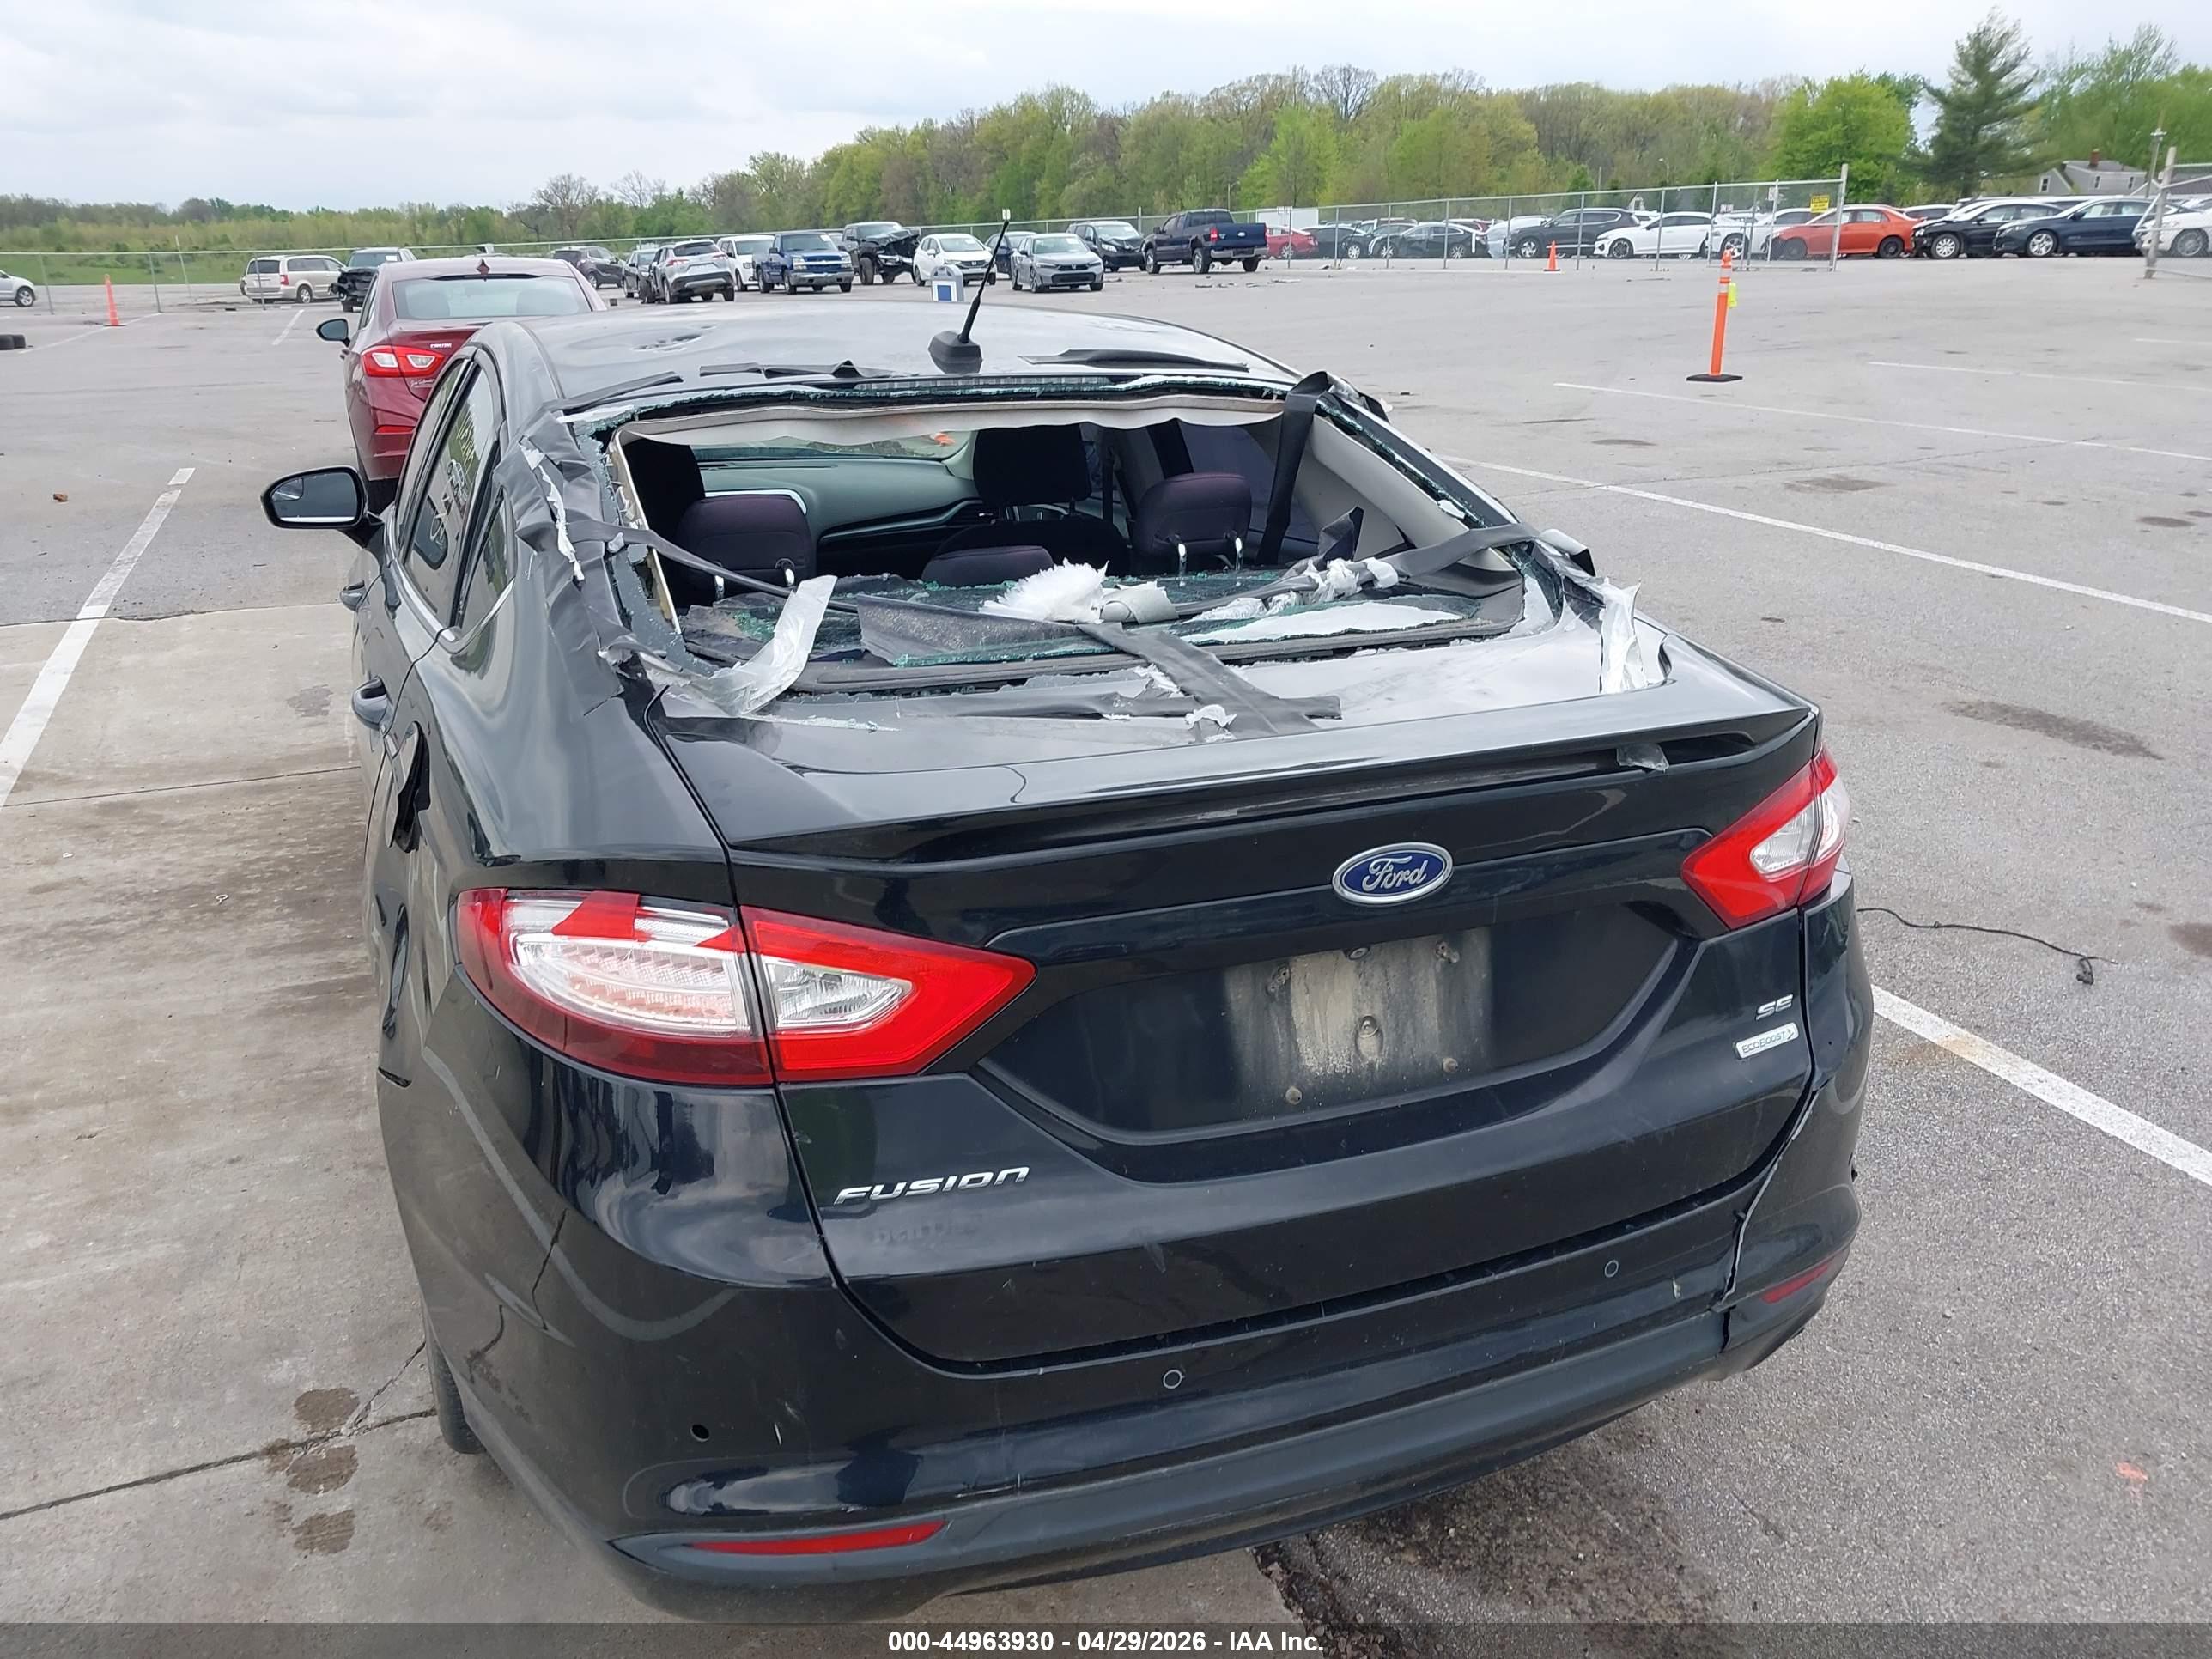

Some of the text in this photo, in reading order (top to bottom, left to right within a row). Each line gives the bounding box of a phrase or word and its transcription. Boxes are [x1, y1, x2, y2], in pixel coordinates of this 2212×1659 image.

[1362, 855, 1429, 892] Ford
[1755, 994, 1794, 1021] SE
[833, 1166, 1030, 1206] FUSION
